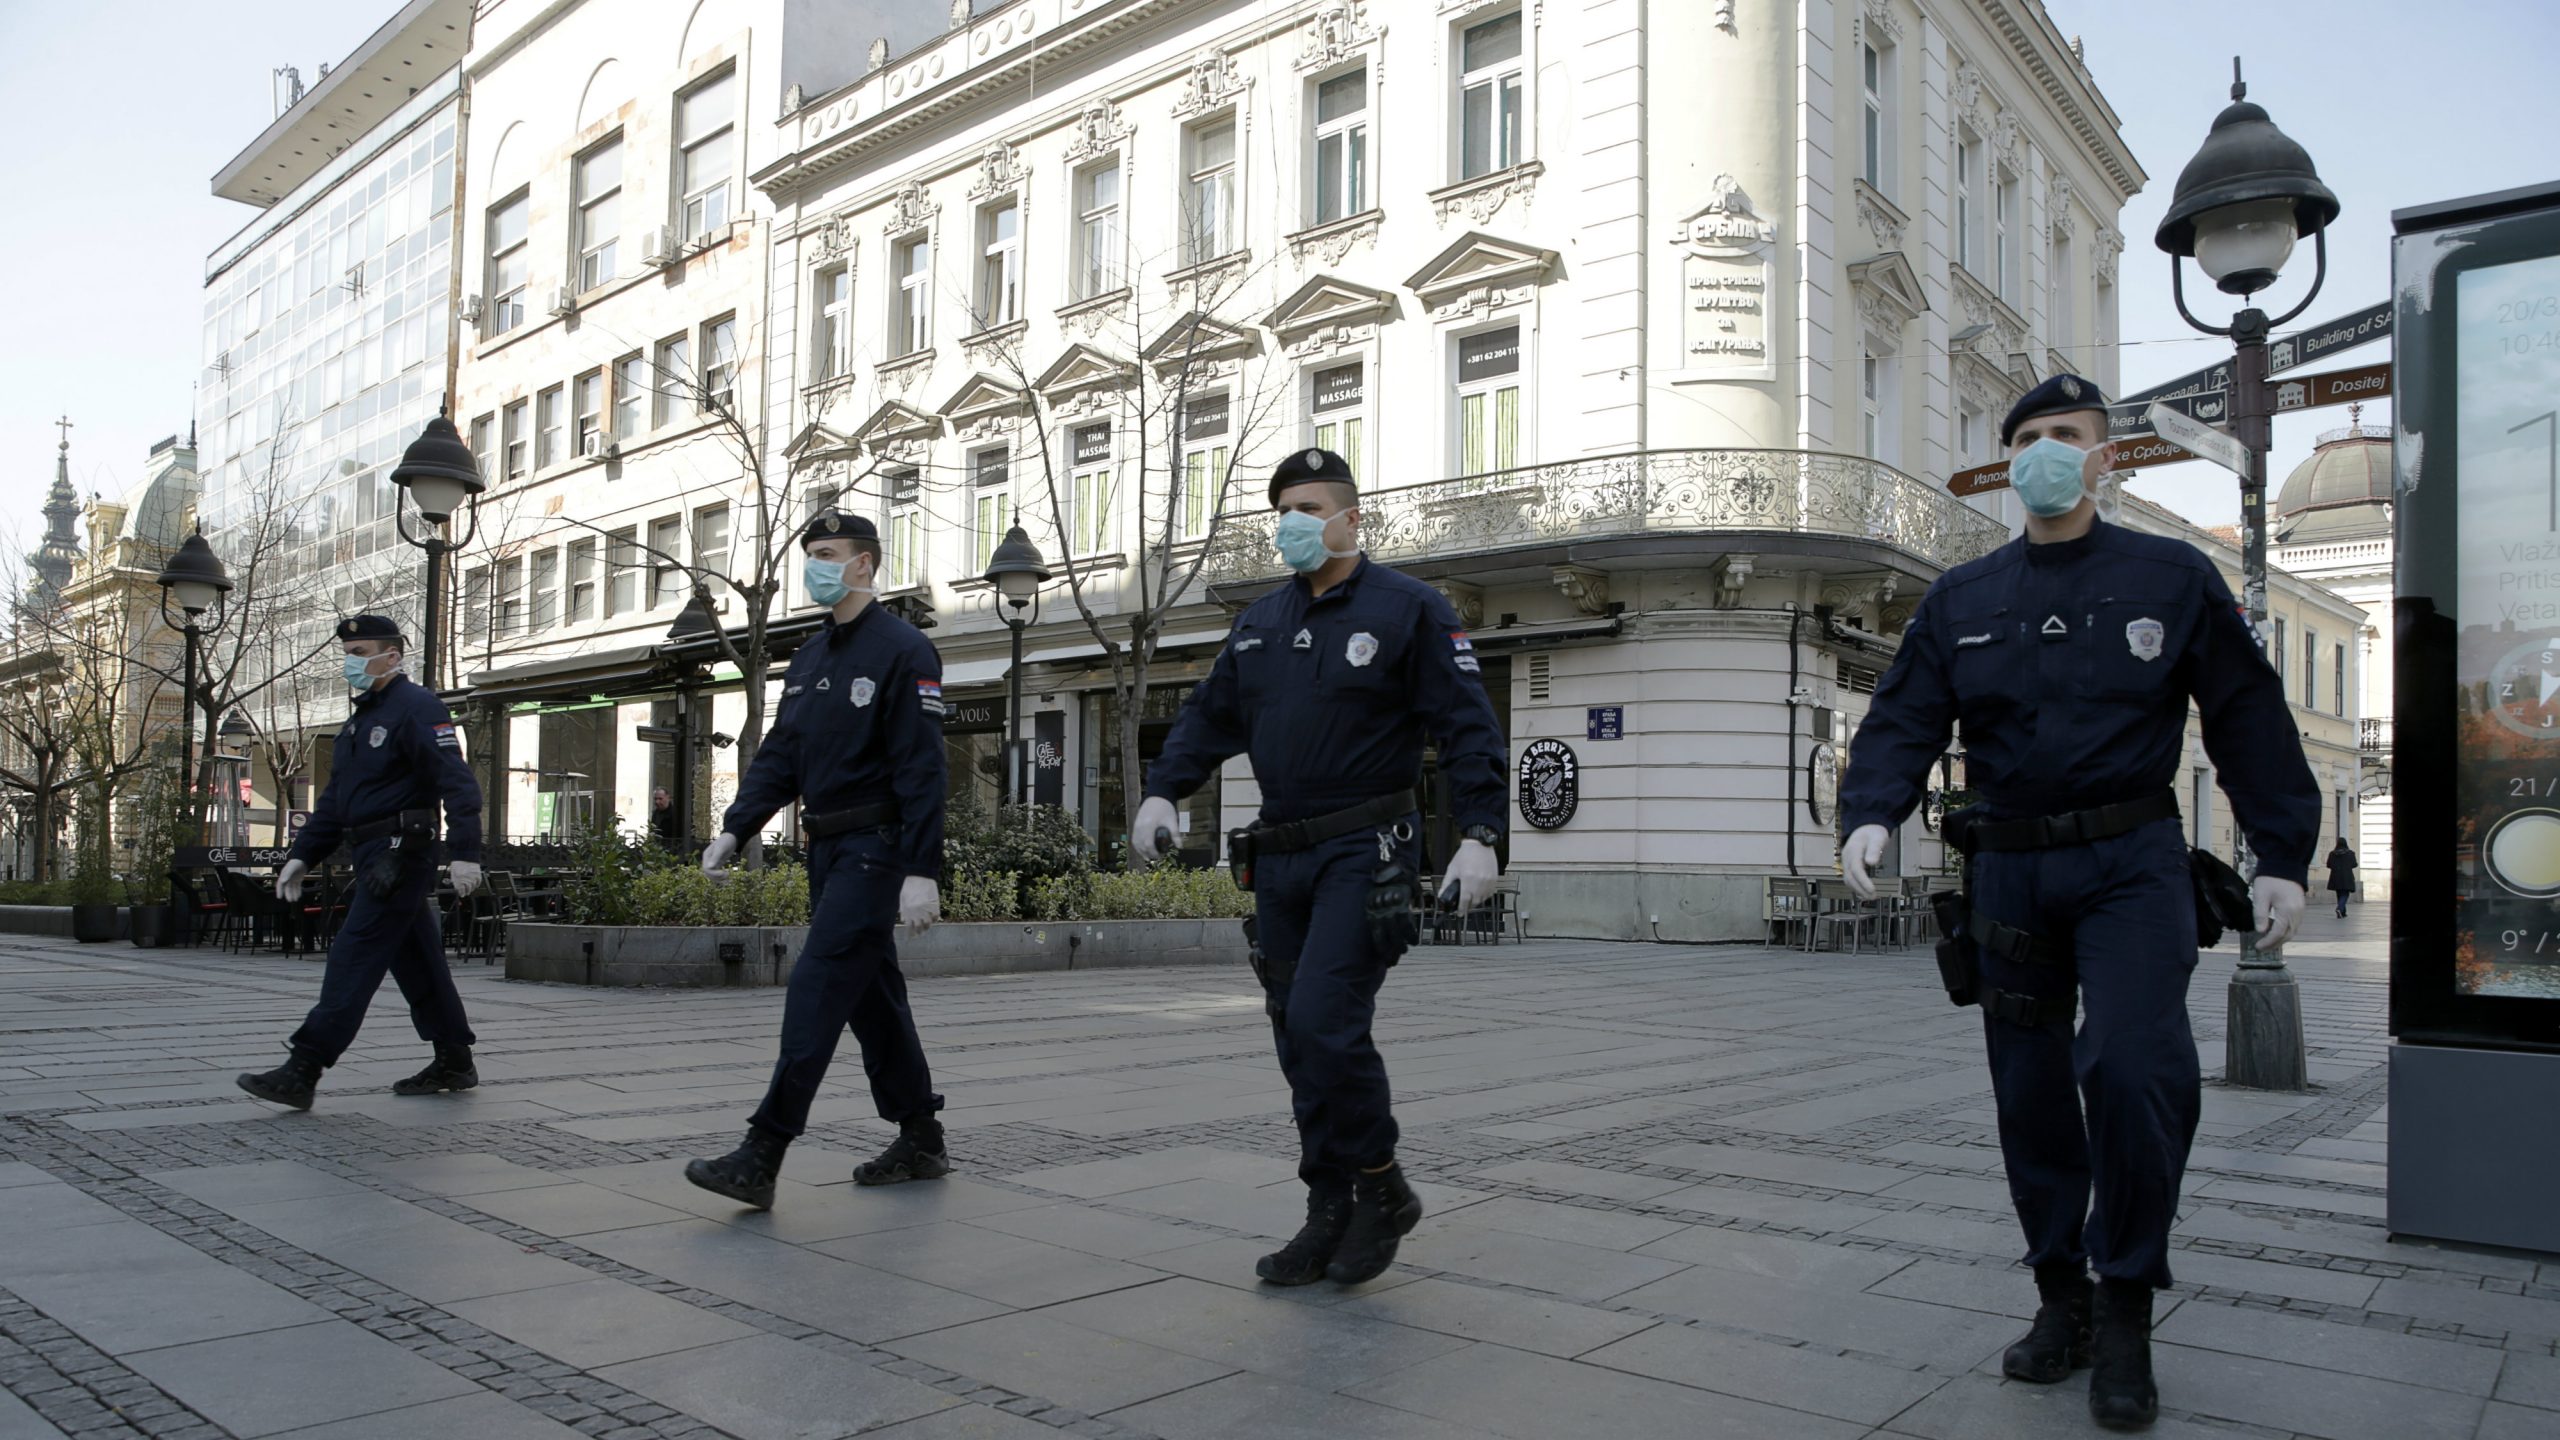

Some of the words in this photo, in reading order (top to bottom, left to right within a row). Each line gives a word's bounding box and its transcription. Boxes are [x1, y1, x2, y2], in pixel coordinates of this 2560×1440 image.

[1695, 220, 1756, 239] СРБИЈА
[1689, 274, 1717, 289] ПРВО
[1721, 273, 1763, 288] СРПСКО
[1694, 295, 1755, 310] ДРУШТВО
[1718, 318, 1733, 330] ЗА
[2306, 327, 2355, 352] Building
[2358, 318, 2372, 334] of
[1689, 336, 1762, 353] ОСИГУРАЊЕ
[1466, 353, 1483, 364] +381
[1484, 351, 1493, 360] 62
[1494, 348, 1507, 359] 204
[1331, 374, 1353, 387] THAI
[2331, 373, 2387, 394] Dositej
[1319, 387, 1363, 405] MASSAGE
[1087, 433, 1105, 443] THAI
[2500, 540, 2560, 562] Vlaž
[2498, 601, 2560, 621] Veta
[2541, 651, 2553, 664] S
[2502, 684, 2514, 696] Z
[2541, 714, 2553, 728] J
[1521, 755, 1532, 780] THE
[1530, 741, 1566, 756] BERRY
[1561, 753, 1574, 779] BAR
[2510, 777, 2536, 797] 21
[208, 847, 237, 862] CAFE
[252, 848, 292, 864] FACTORY
